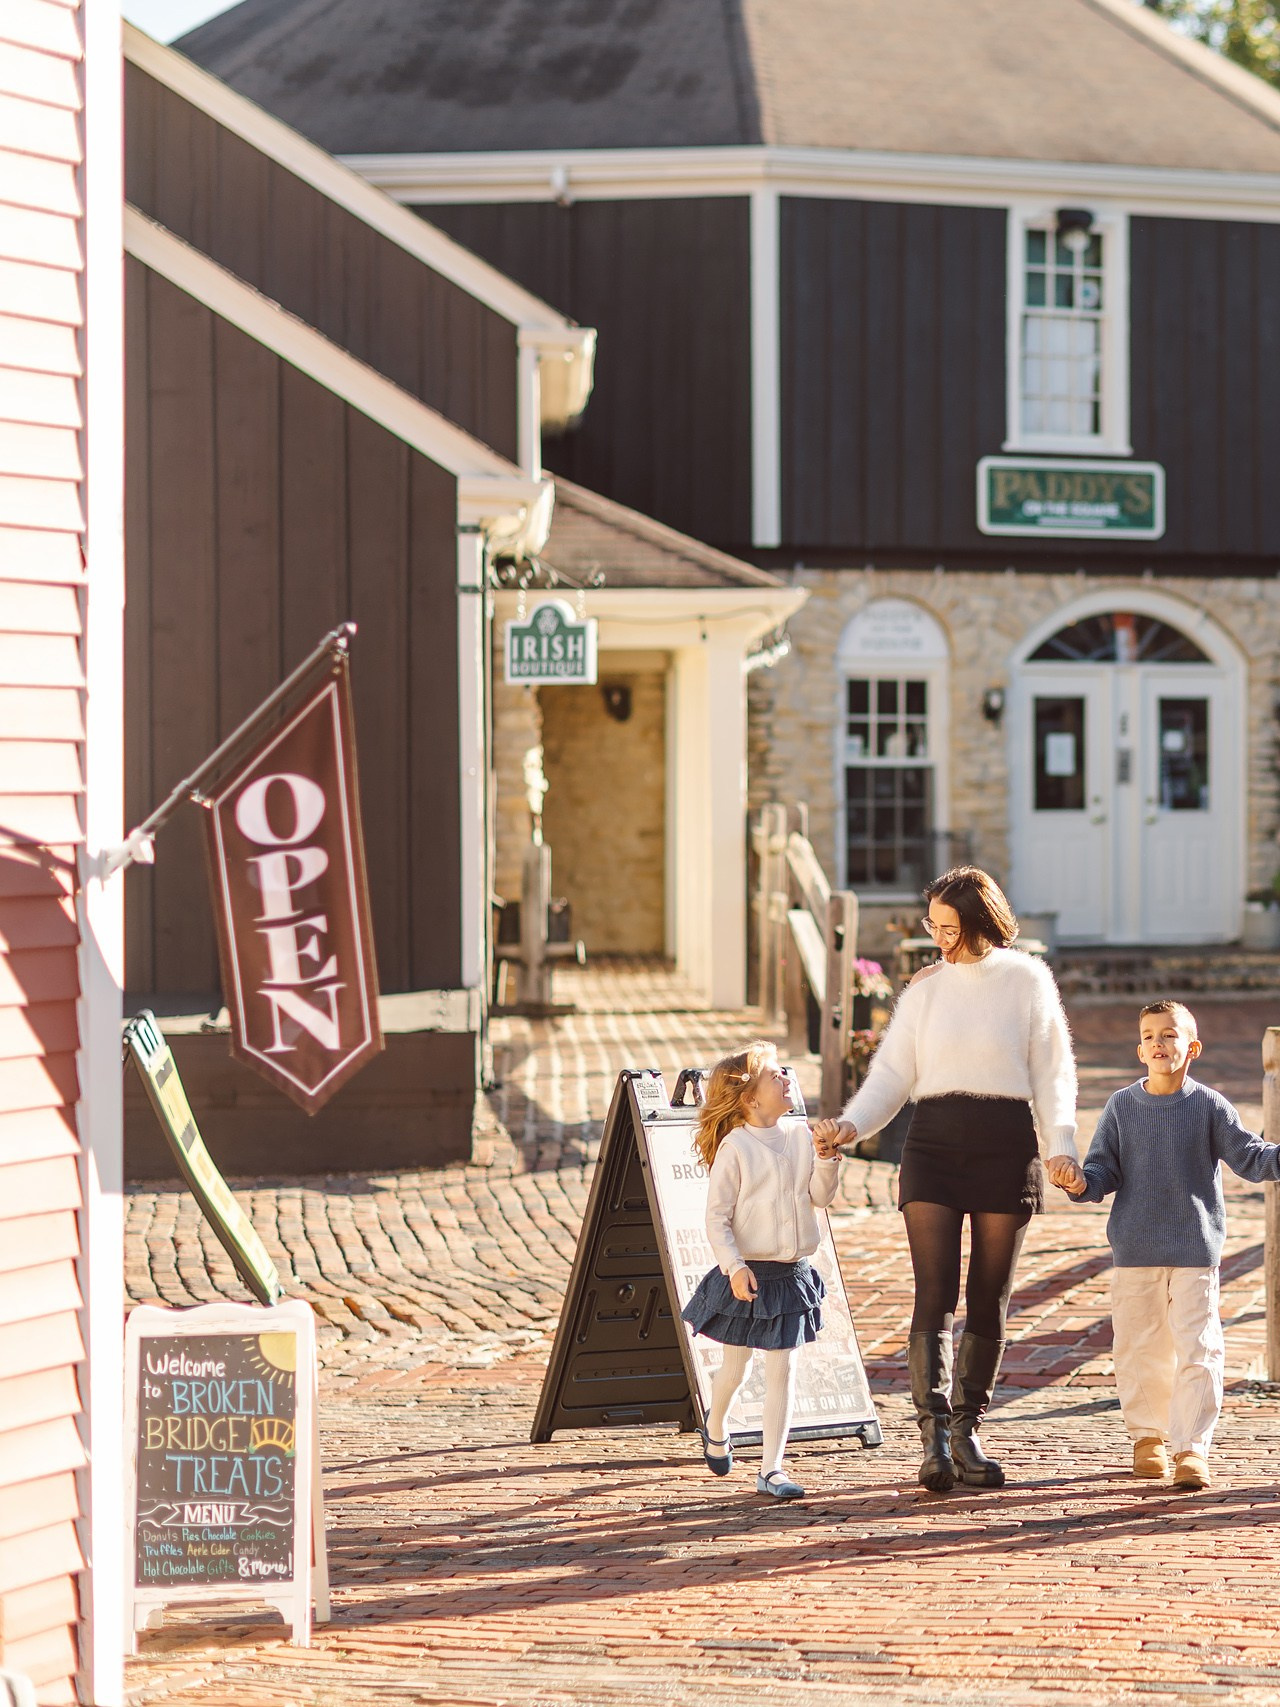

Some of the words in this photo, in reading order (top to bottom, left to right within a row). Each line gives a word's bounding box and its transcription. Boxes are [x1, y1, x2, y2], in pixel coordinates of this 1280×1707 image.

[993, 470, 1152, 515] PADDY'S
[511, 634, 584, 661] IRISH
[511, 661, 584, 678] BOUTIQUE
[235, 773, 347, 1053] OPEN
[671, 1163, 710, 1180] BRO
[676, 1228, 706, 1245] APPL
[146, 1351, 227, 1377] Welcome
[143, 1377, 162, 1399] to
[172, 1379, 275, 1415] BROKEN
[793, 1397, 818, 1412] OME
[820, 1394, 837, 1410] ON
[838, 1393, 857, 1409] IN!
[144, 1416, 248, 1453] BRIDGE
[165, 1454, 283, 1497] TREATS
[183, 1503, 236, 1524] MENU
[143, 1529, 179, 1542] Donuts
[182, 1528, 200, 1541] Pies
[202, 1527, 236, 1541] Chocolate
[240, 1529, 276, 1542] Cookies
[143, 1544, 183, 1557] Truffles
[187, 1543, 208, 1556] Apple
[210, 1543, 230, 1556] Cider
[233, 1542, 260, 1556] Candy
[143, 1560, 160, 1577] Hot
[162, 1557, 205, 1576] Chocolate
[207, 1559, 235, 1576] Gifts
